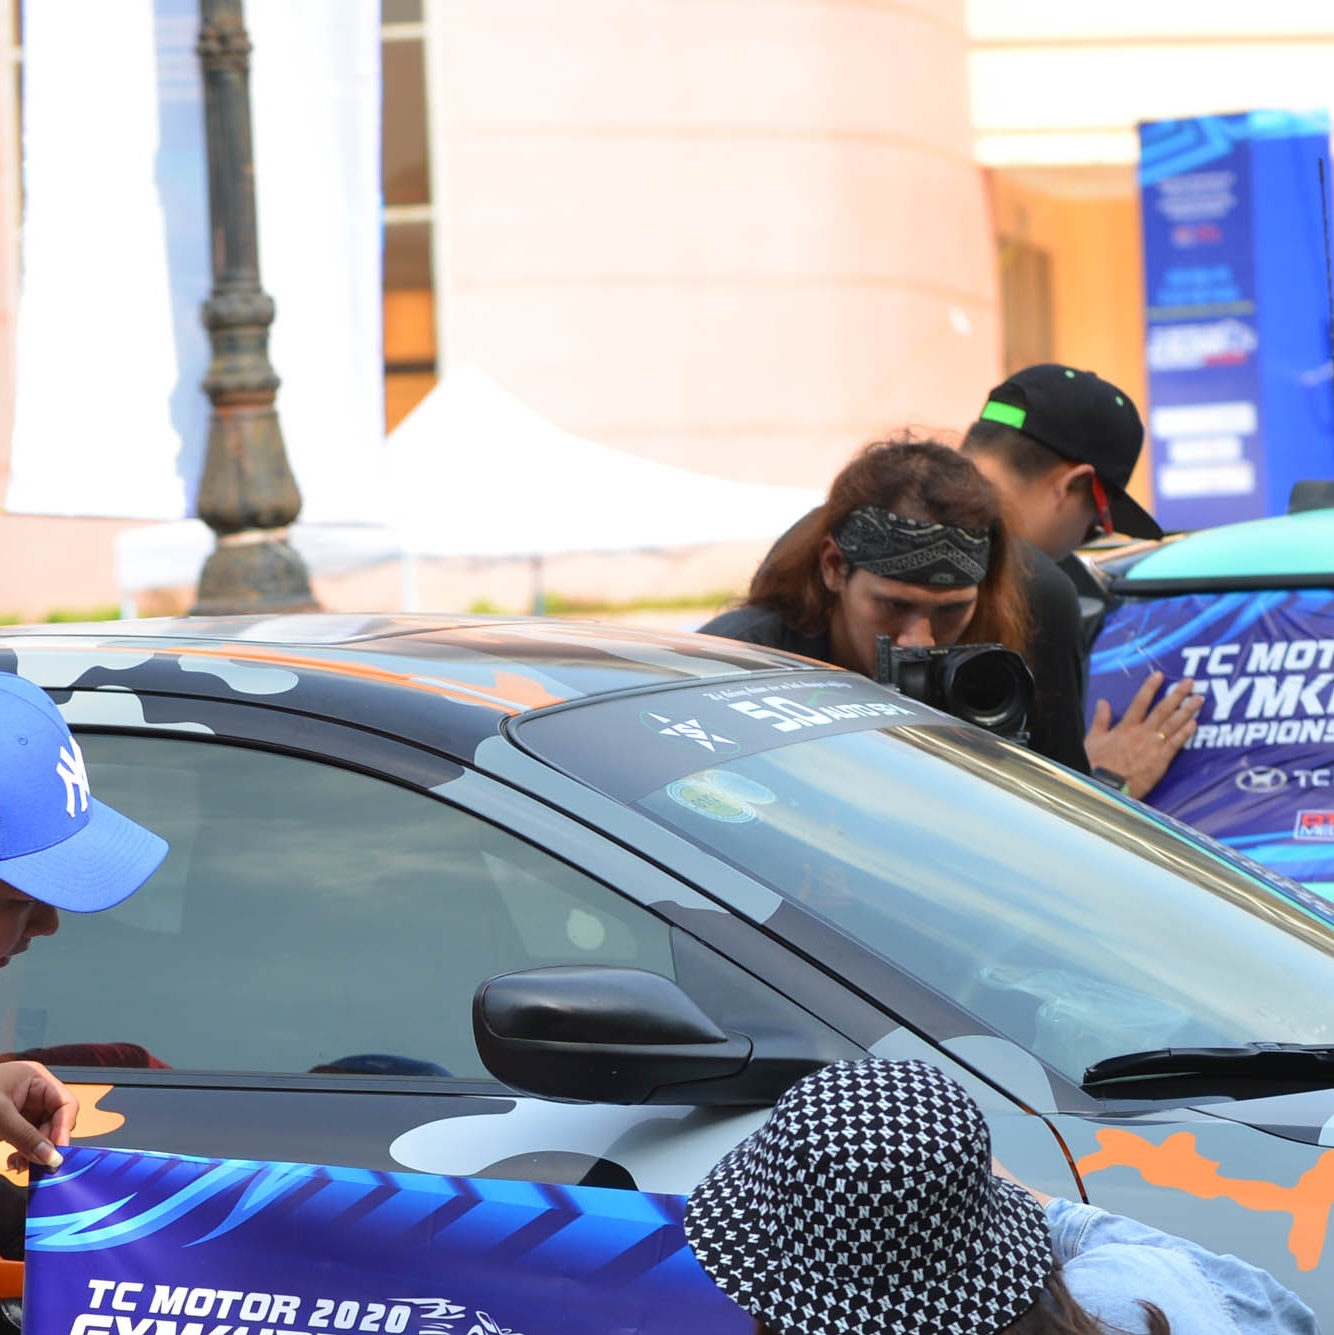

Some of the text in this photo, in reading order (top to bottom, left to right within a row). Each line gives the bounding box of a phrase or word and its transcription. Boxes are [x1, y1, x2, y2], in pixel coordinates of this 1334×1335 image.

[1181, 643, 1240, 677] TC
[1293, 769, 1330, 788] TC
[88, 1279, 411, 1334] TC MOTOR 2020
